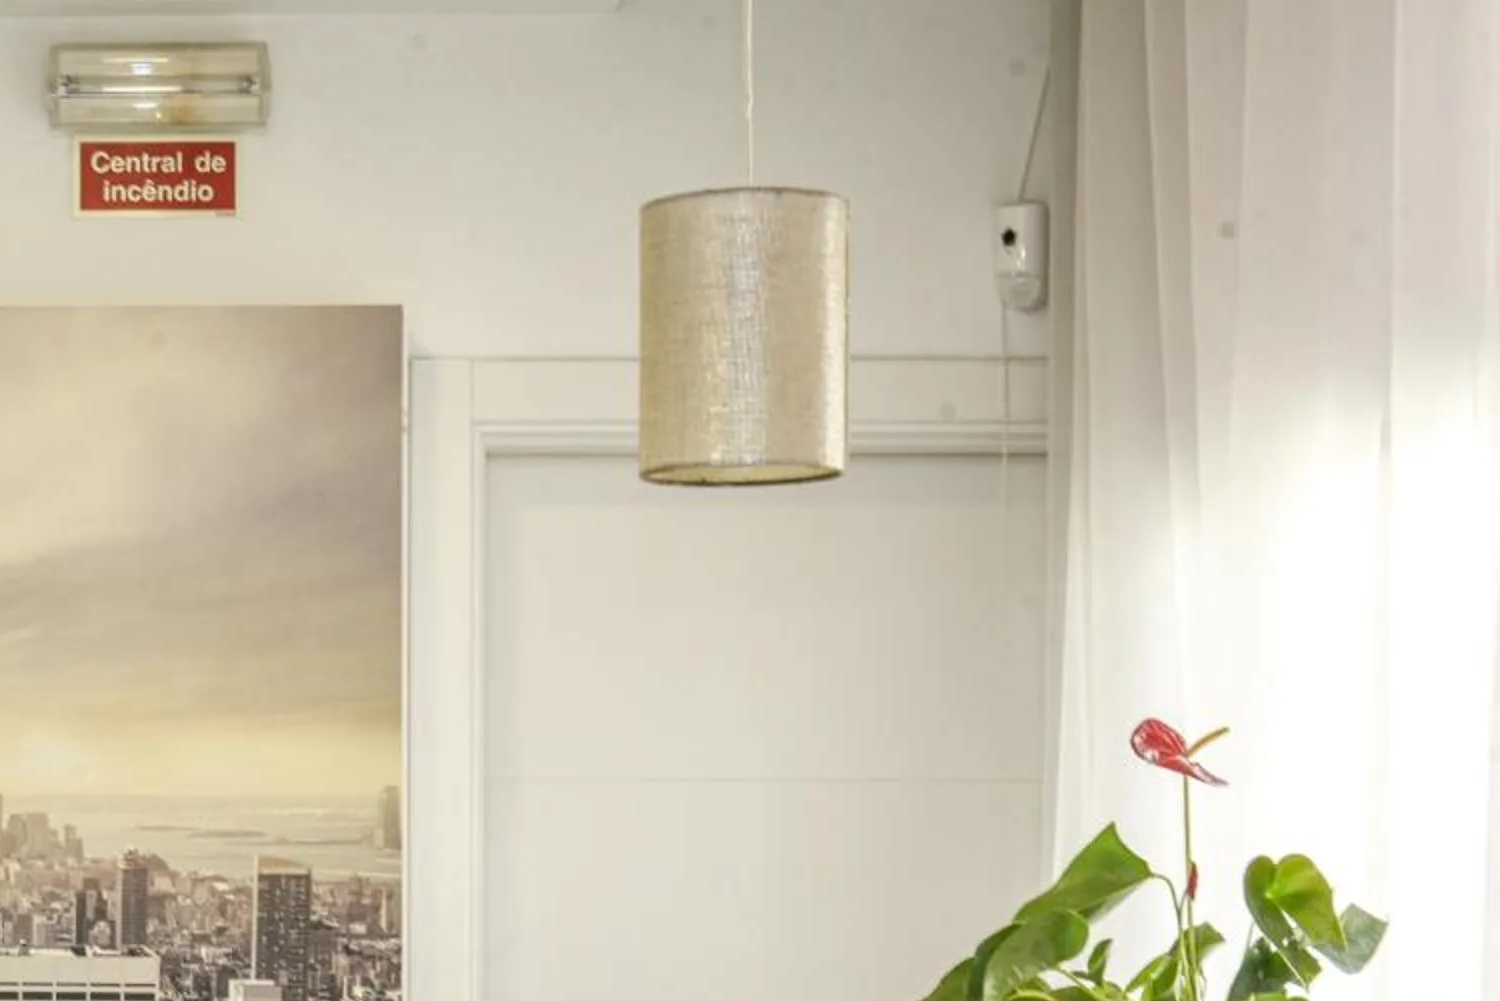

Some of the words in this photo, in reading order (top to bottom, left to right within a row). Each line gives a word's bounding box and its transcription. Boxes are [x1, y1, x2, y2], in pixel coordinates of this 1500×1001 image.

[91, 151, 183, 174] Central
[194, 151, 227, 173] de
[102, 180, 215, 203] incêndio
